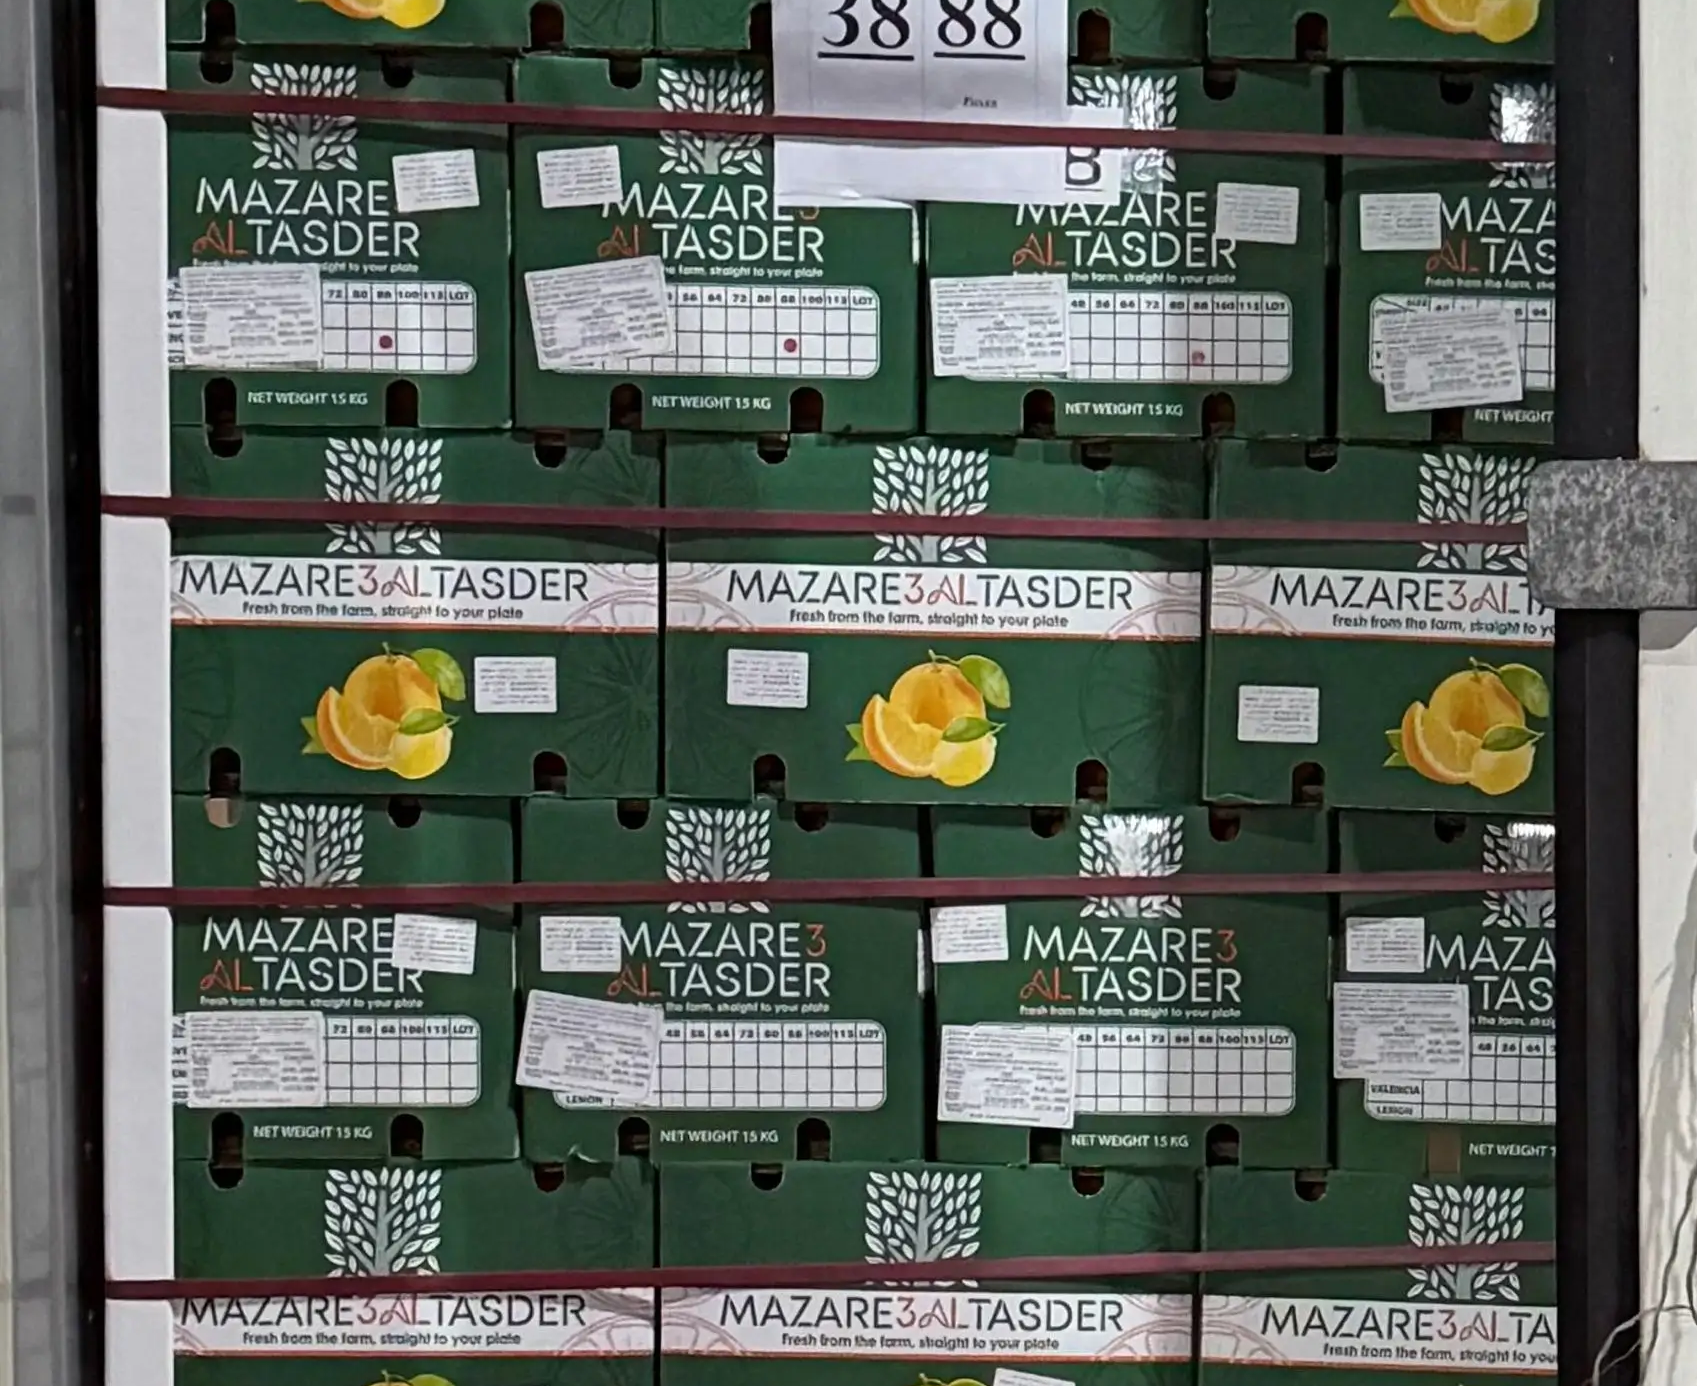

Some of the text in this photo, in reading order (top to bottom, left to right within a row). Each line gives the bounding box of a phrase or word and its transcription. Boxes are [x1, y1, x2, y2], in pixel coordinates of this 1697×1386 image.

[197, 178, 393, 217] MAZARE
[652, 395, 772, 410] NET WEIGHT 15 KG
[203, 916, 394, 955] MAZARE
[660, 1129, 779, 1144] NET WEIGHT 15 KG
